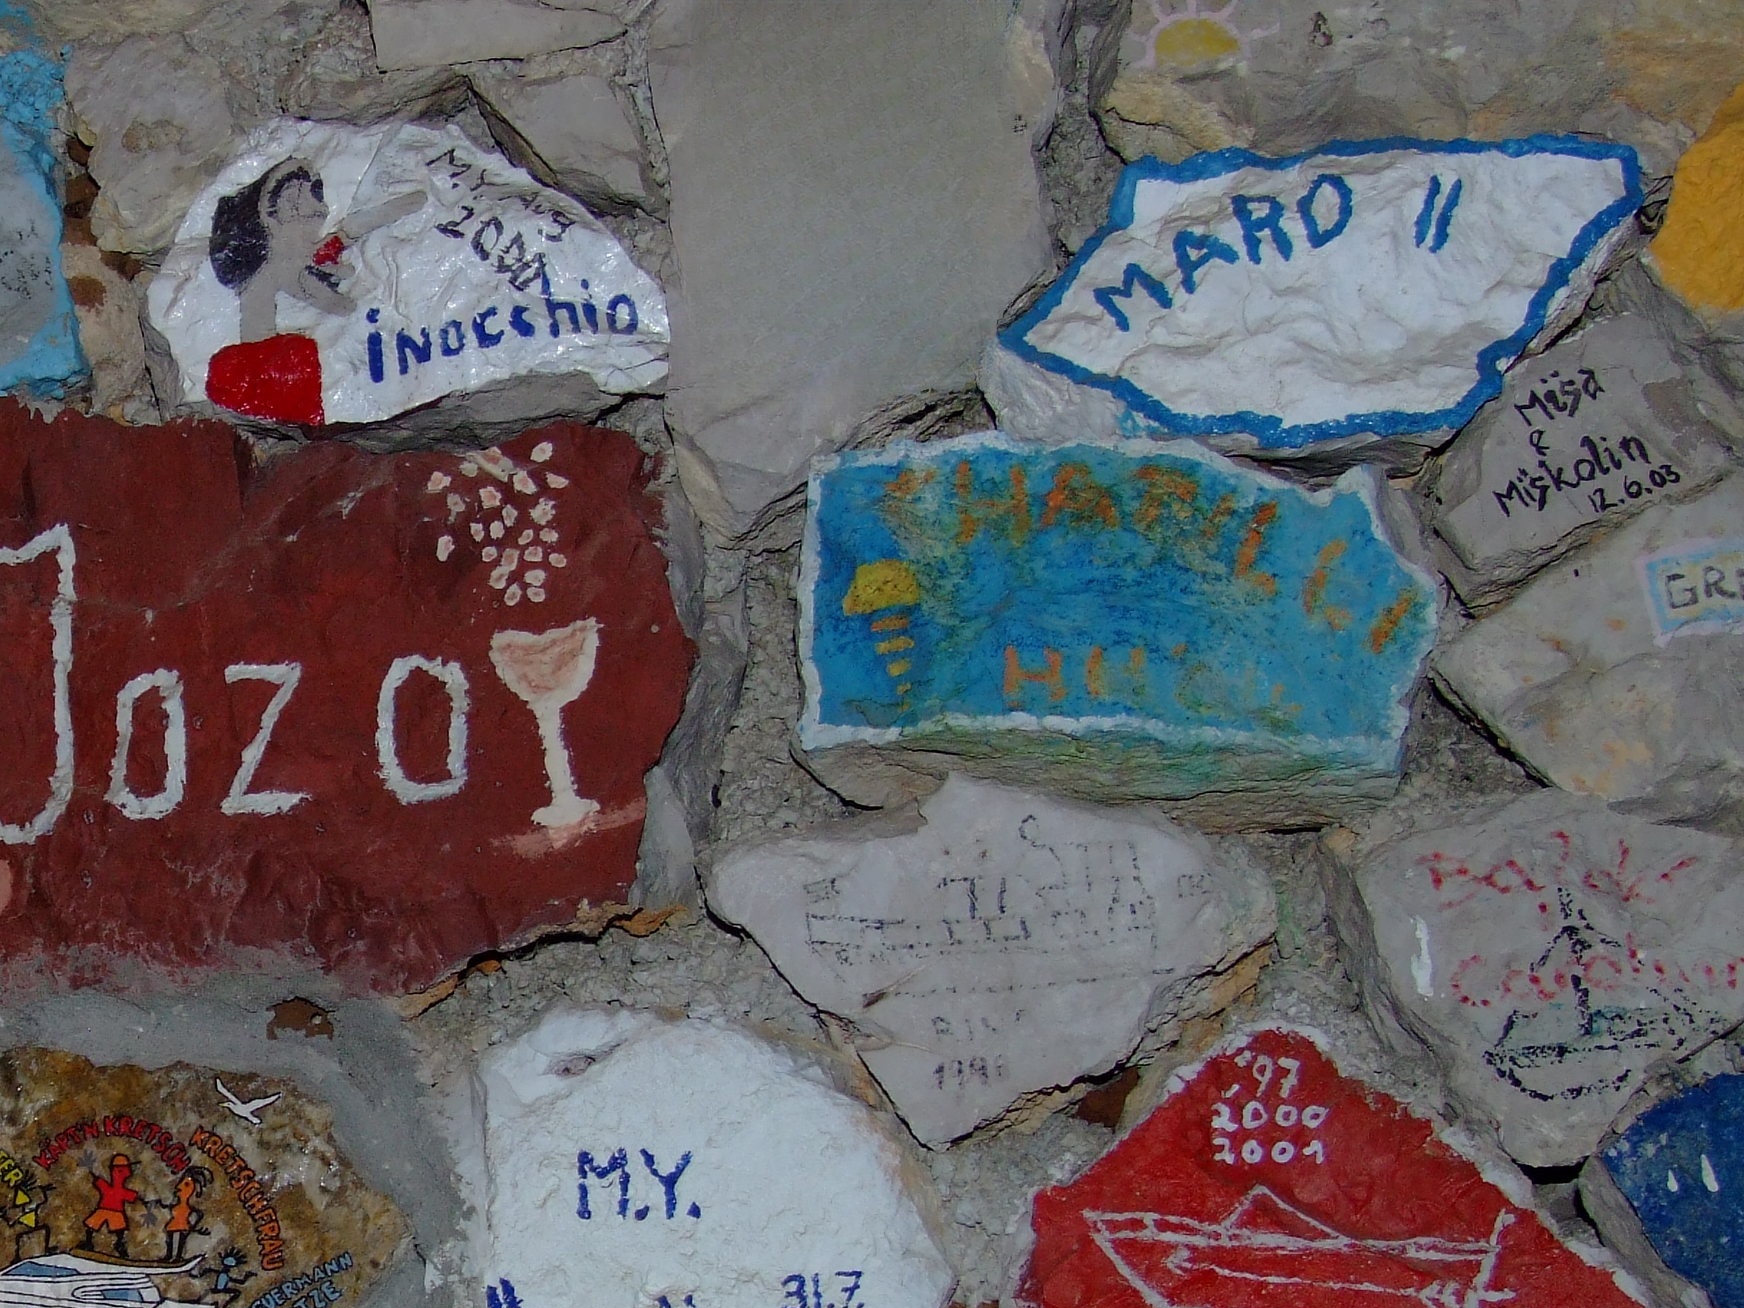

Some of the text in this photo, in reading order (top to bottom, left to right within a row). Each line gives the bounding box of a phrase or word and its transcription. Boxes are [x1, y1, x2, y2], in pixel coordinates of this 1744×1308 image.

[103, 1113, 192, 1175] KRETSCH
[188, 1124, 285, 1272] KRETSCHFRAU
[575, 1147, 703, 1221] M.Y.
